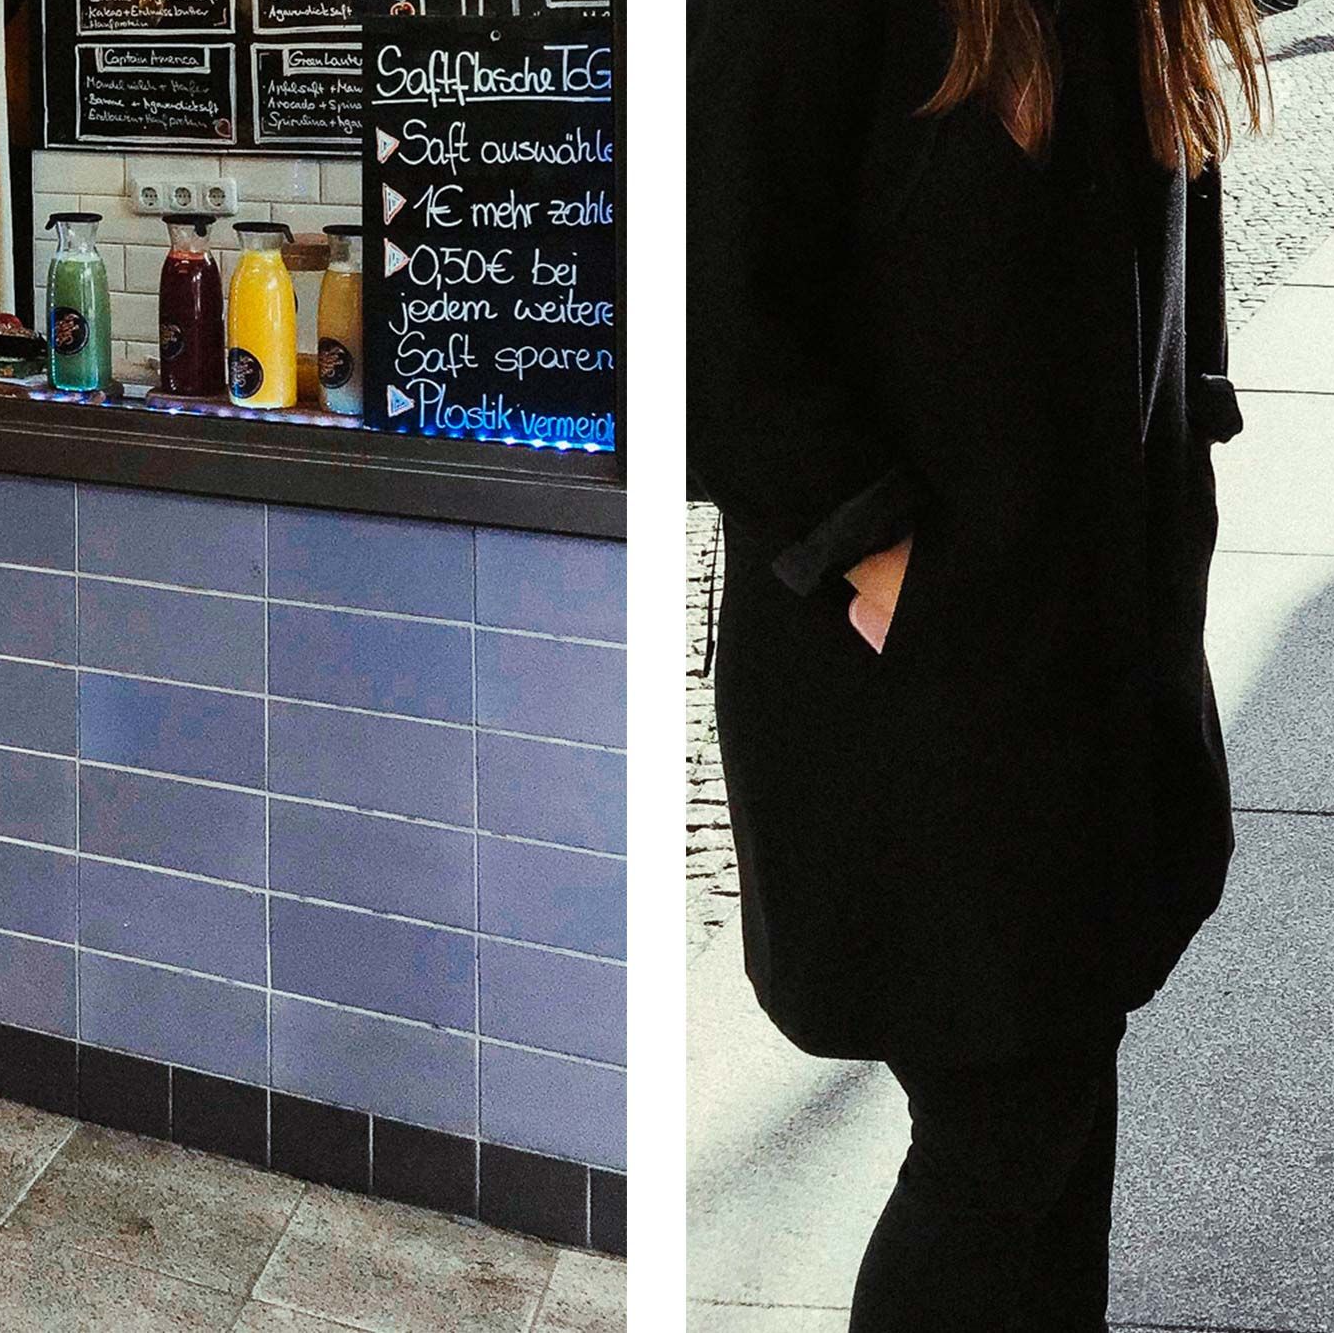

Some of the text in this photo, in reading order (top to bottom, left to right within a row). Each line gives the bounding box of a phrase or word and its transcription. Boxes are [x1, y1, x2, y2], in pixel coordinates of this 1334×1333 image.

[376, 44, 556, 108] Saftflasche
[398, 118, 472, 176] Saft
[412, 184, 464, 228] 1€
[470, 189, 540, 231] mehr
[408, 244, 579, 291] 0,50€ bei
[388, 291, 498, 336] jedem
[394, 331, 479, 379] Saft
[494, 345, 615, 382] sparen
[405, 377, 514, 431] Plastik
